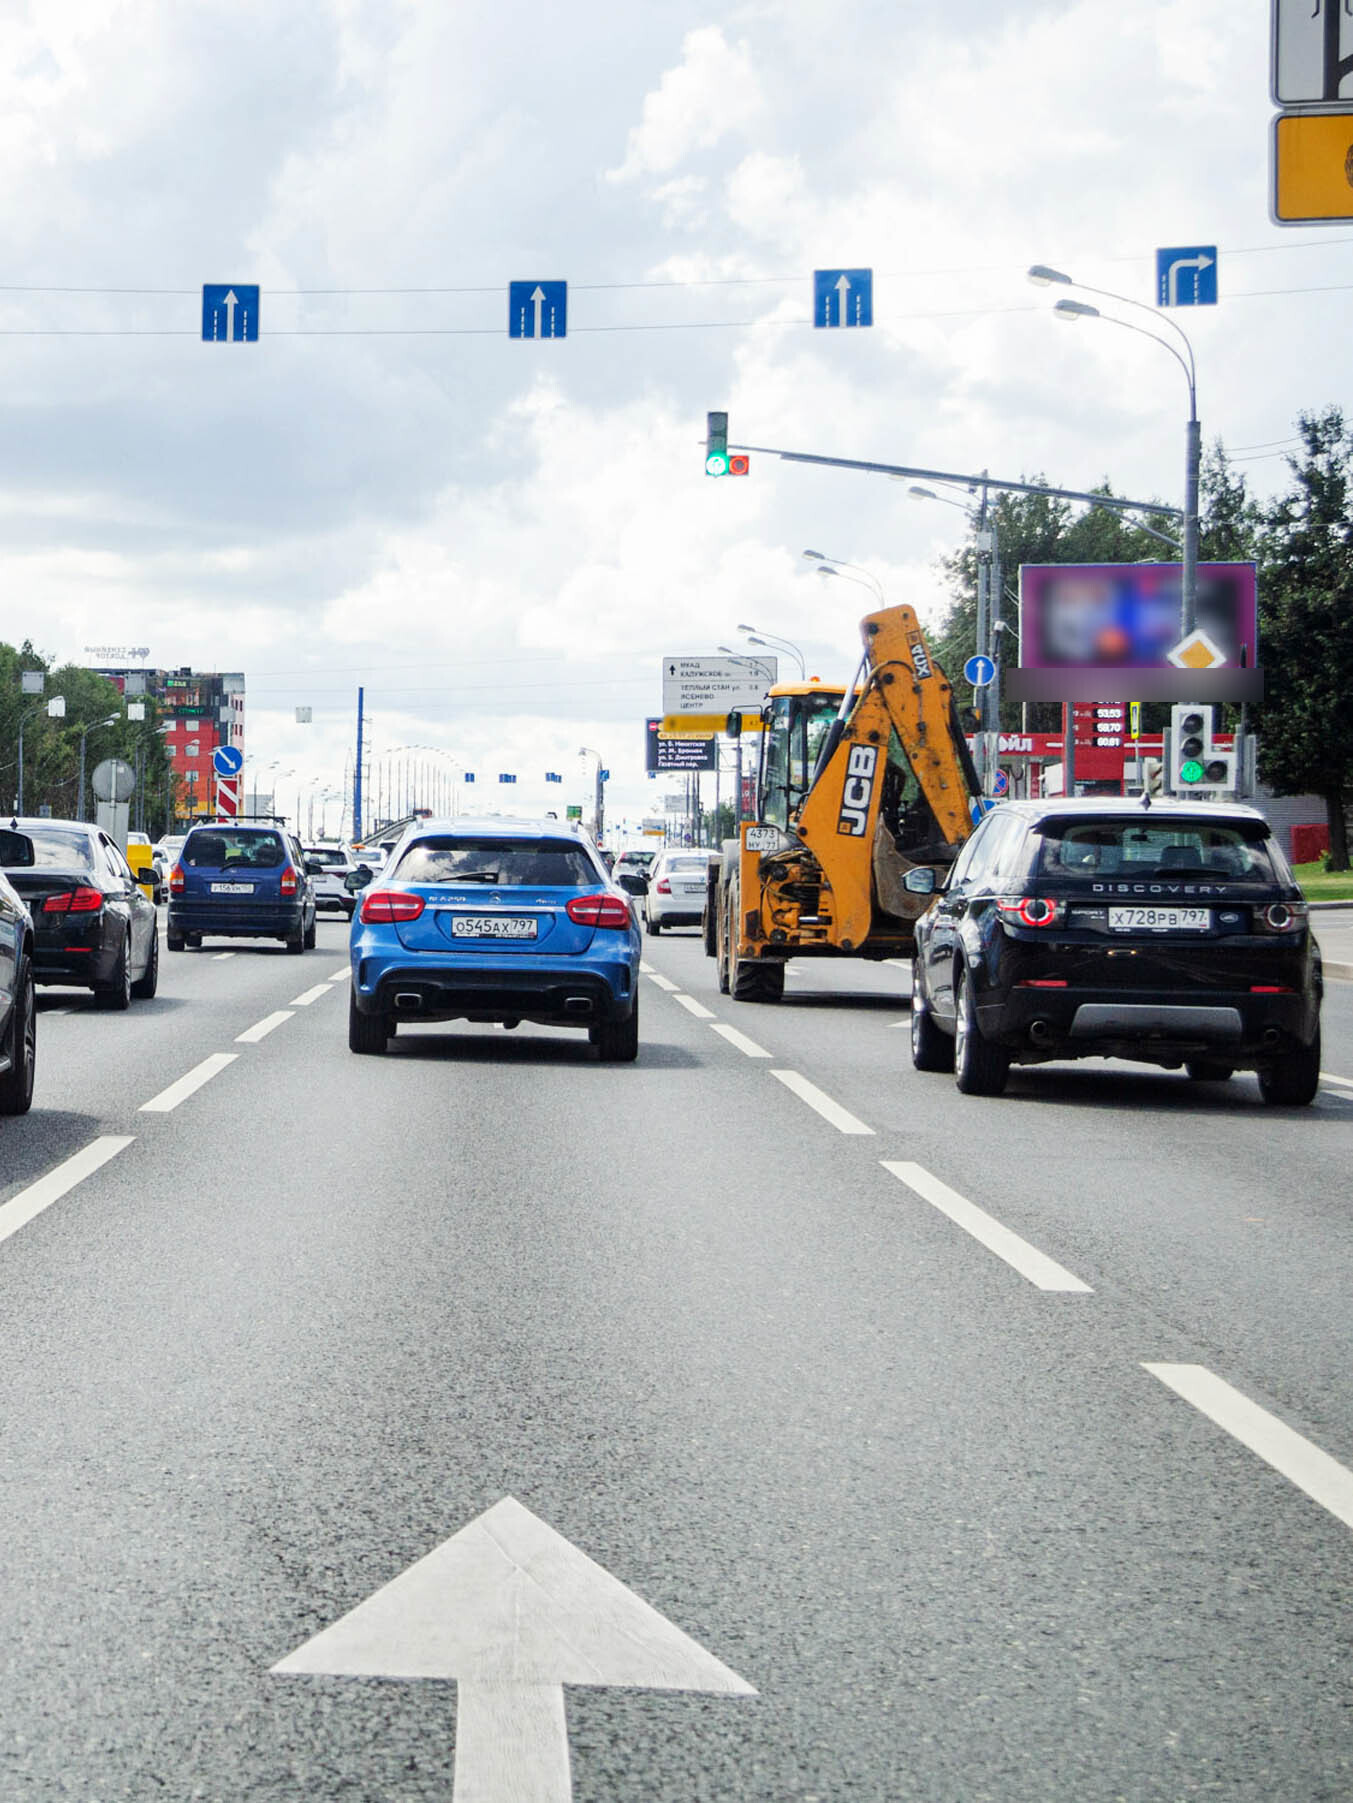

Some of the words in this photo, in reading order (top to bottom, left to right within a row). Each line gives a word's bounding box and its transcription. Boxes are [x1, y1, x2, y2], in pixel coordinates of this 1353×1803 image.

[840, 746, 879, 835] JCB
[750, 829, 776, 839] 4373
[767, 841, 777, 849] 77
[1092, 884, 1227, 894] DISCOVERY
[1115, 910, 1177, 925] Х728РВ
[1181, 910, 1205, 922] 797
[456, 919, 509, 933] О545АХ
[512, 919, 533, 930] 797
